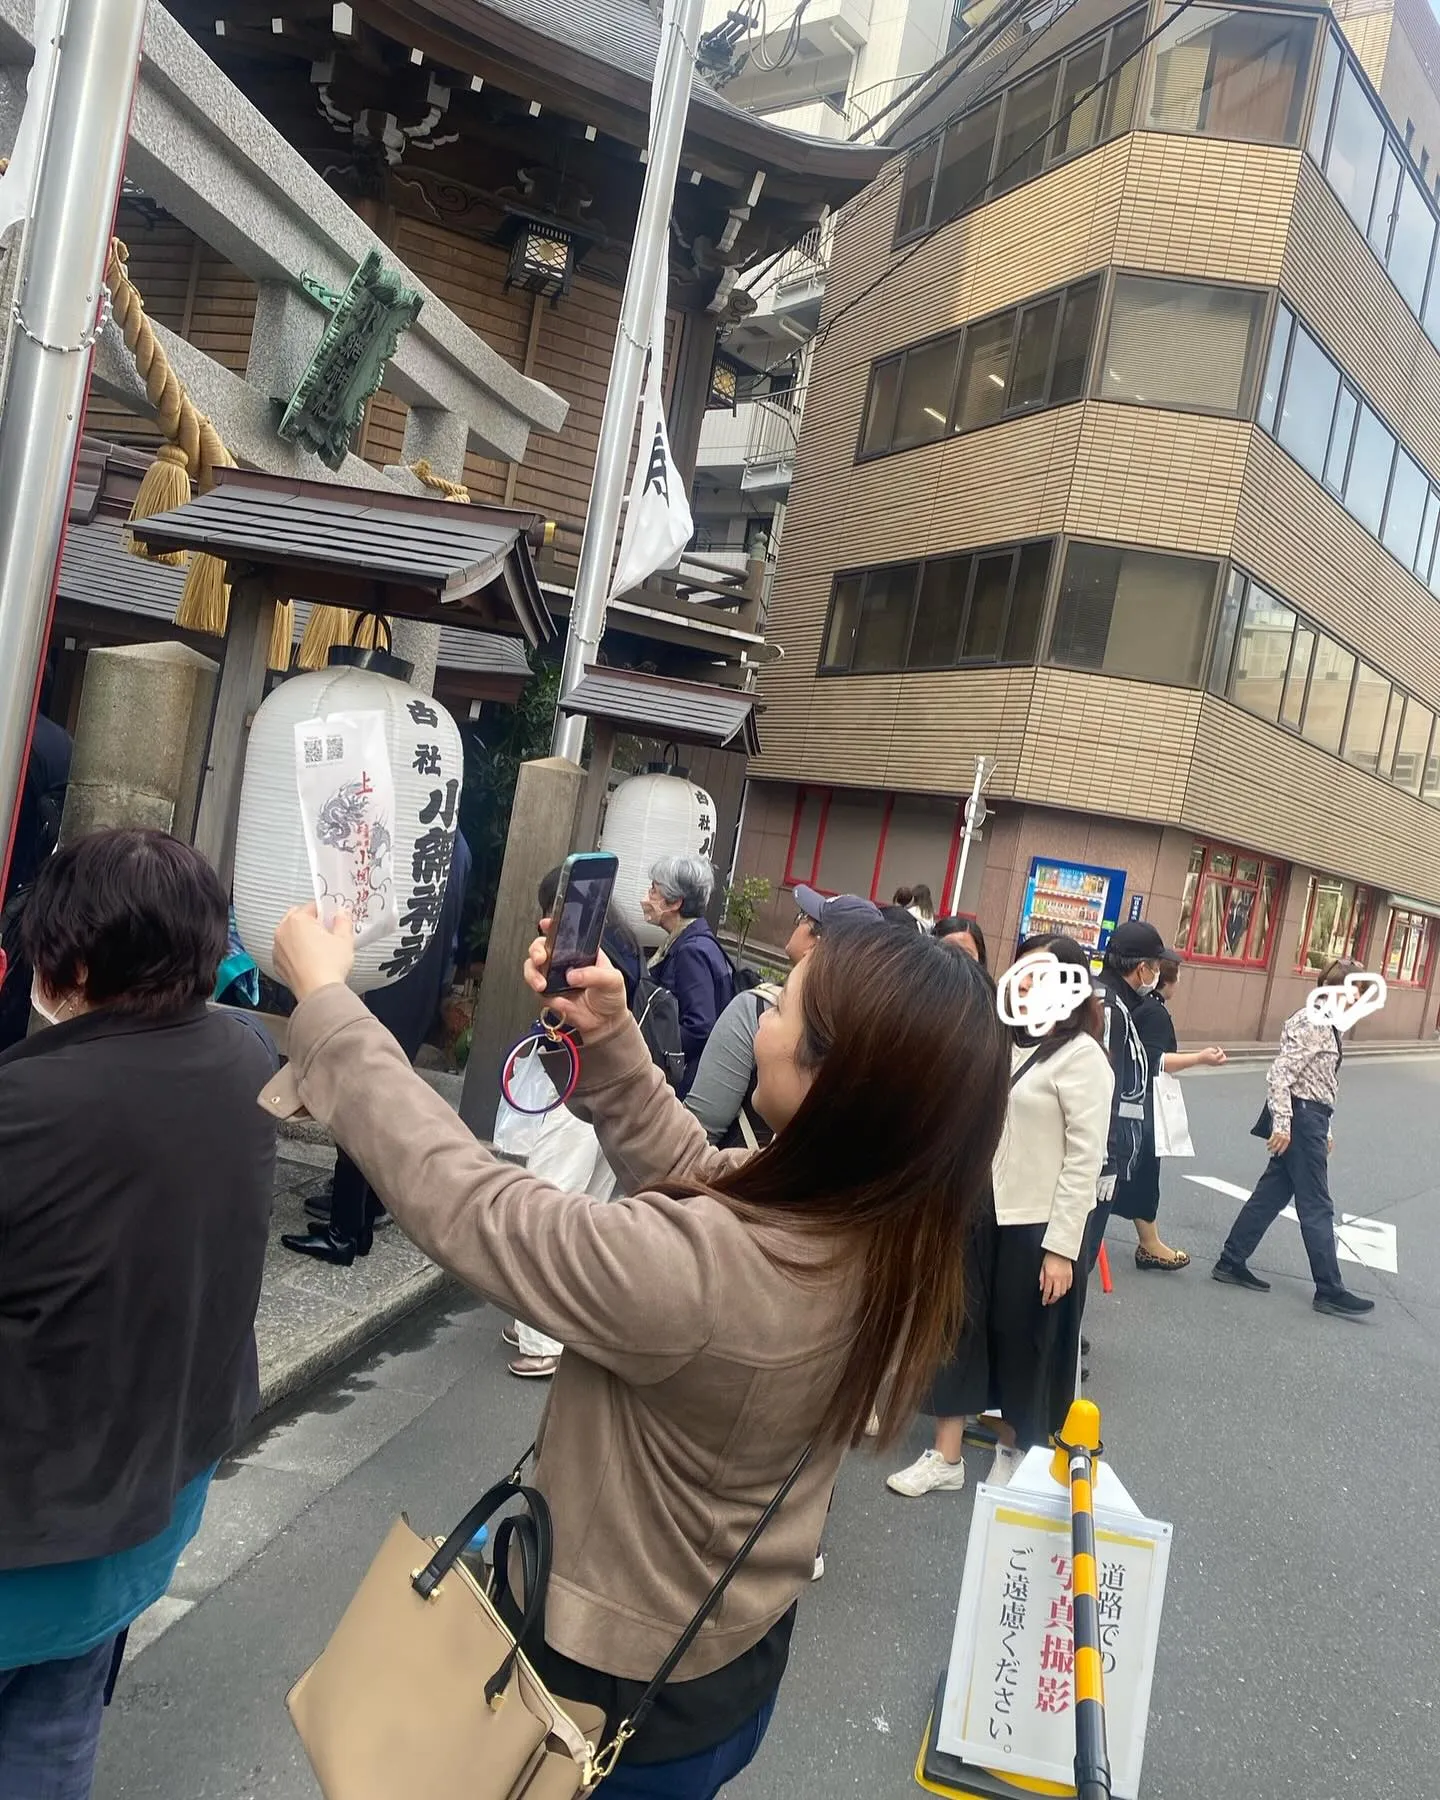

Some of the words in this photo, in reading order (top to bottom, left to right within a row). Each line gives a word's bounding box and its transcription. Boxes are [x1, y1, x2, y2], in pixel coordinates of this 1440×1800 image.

[355, 770, 374, 796] 上
[988, 1546, 1034, 1754] ご遠慮ください。
[1034, 1553, 1073, 1714] 写真撮影
[1099, 1562, 1126, 1673] 道路での
